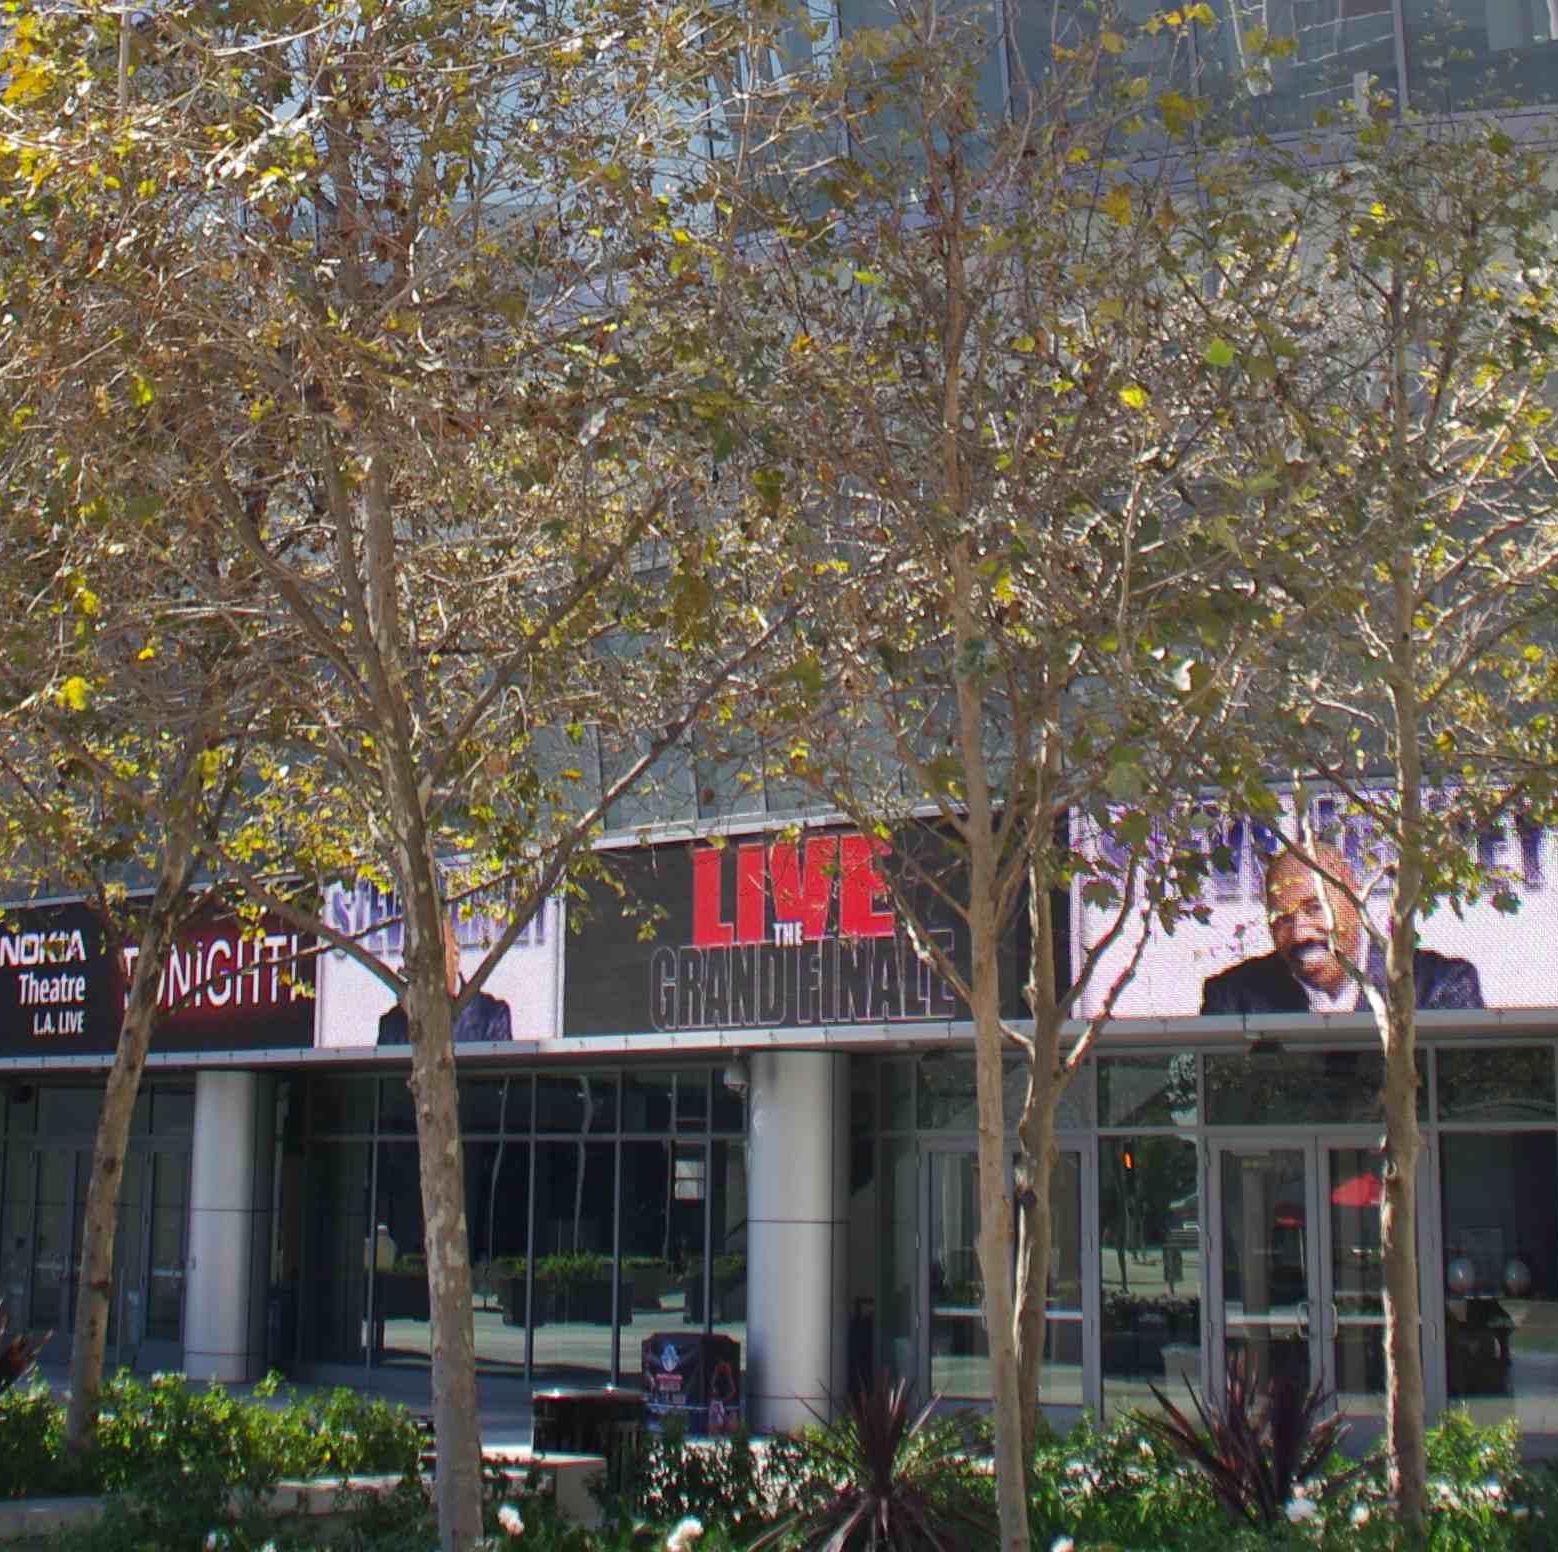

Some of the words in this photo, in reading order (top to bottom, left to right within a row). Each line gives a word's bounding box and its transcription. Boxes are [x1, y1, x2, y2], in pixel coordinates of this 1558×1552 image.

[693, 832, 896, 949] LIVE
[773, 920, 804, 947] THE
[19, 970, 86, 1005] Theatre
[650, 944, 788, 1033] GRAND
[796, 926, 956, 1025] FINALE
[33, 1011, 56, 1035] L.A.
[58, 1010, 85, 1034] LIVE
